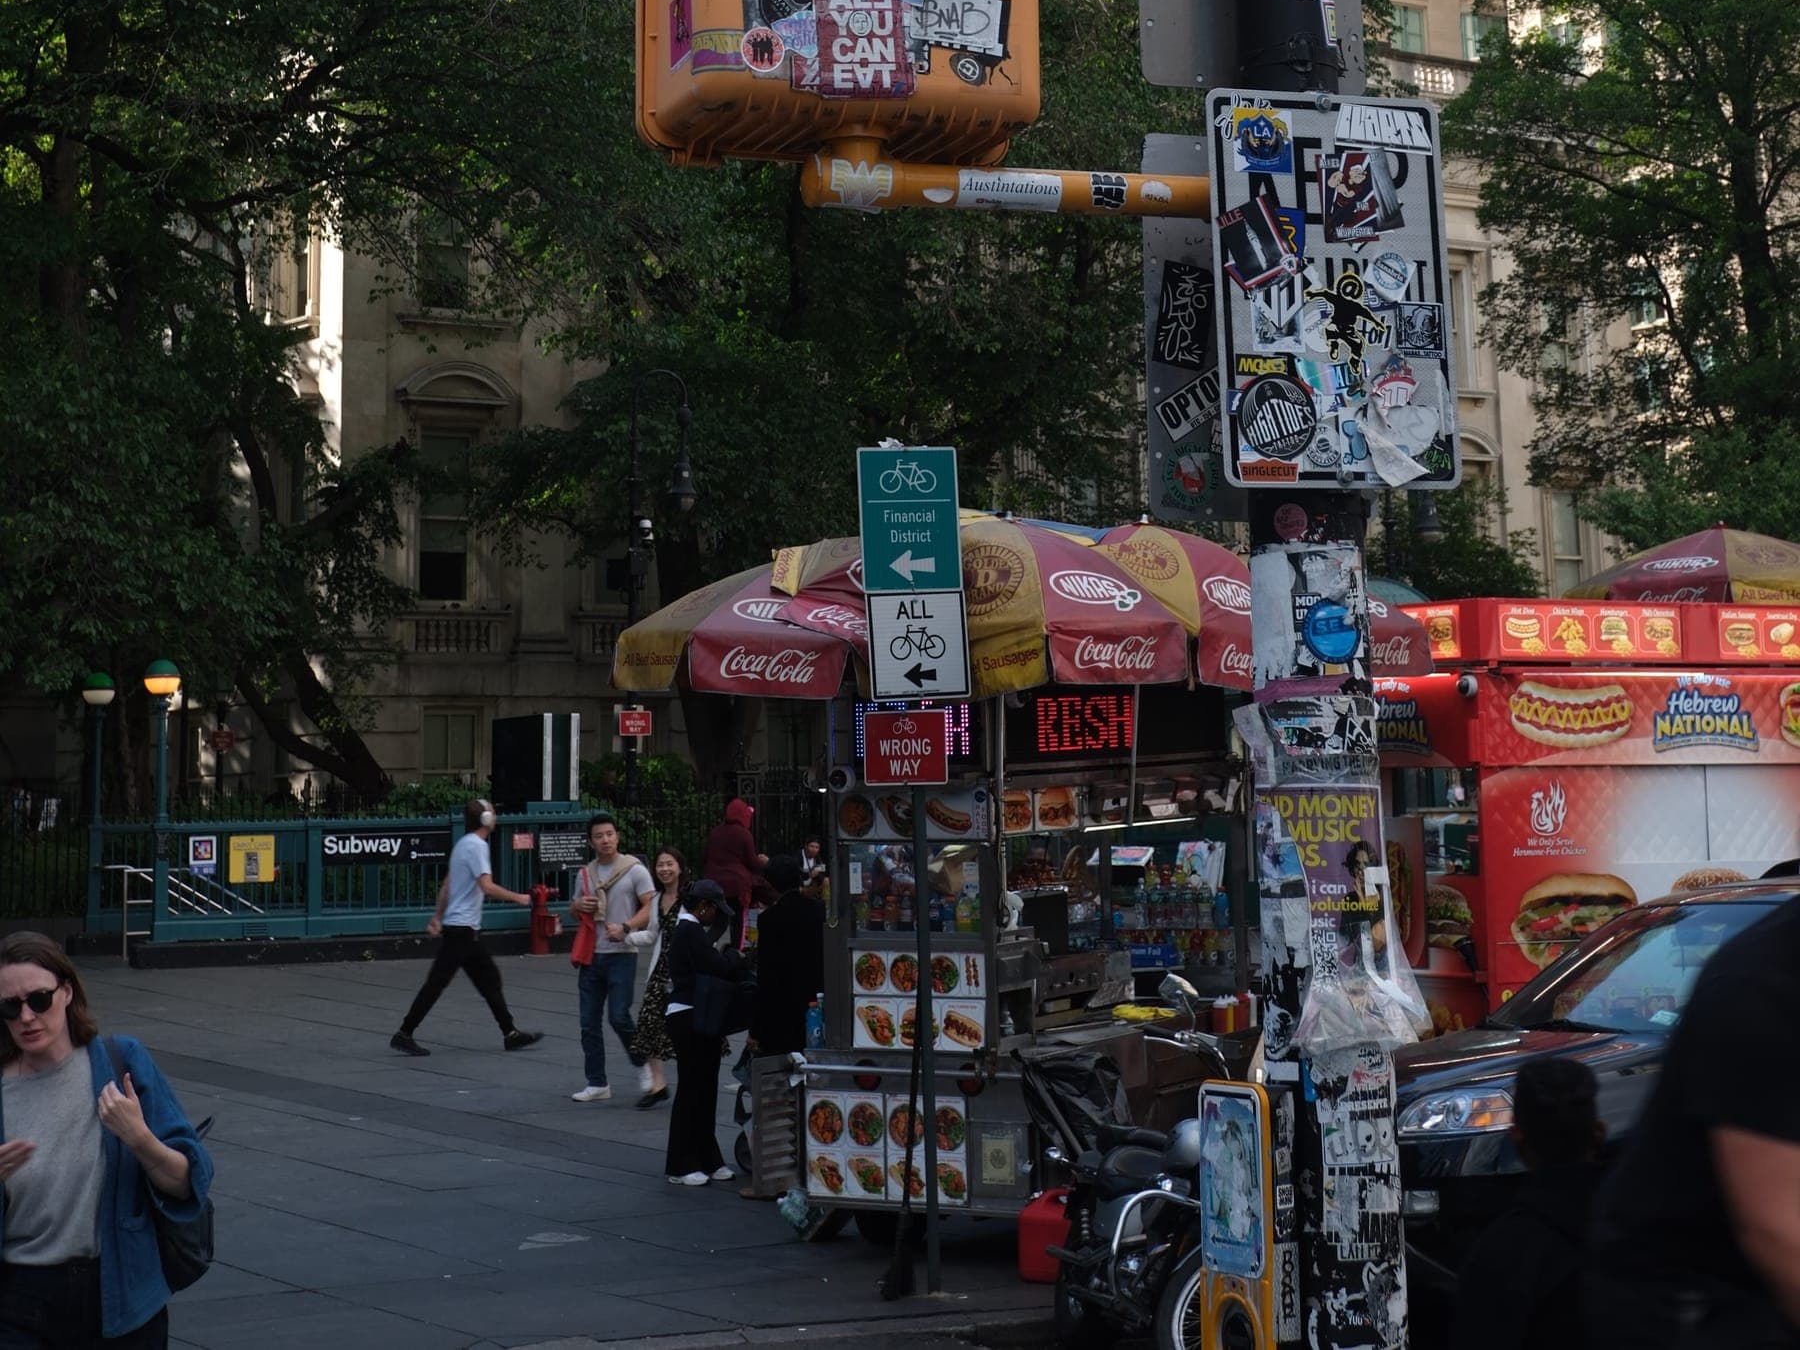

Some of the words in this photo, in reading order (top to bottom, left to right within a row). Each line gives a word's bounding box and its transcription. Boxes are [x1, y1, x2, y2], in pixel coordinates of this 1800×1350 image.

[829, 11, 893, 37] YOU
[832, 38, 895, 63] CAN
[833, 63, 896, 89] EAT
[1254, 125, 1271, 138] LA
[963, 177, 1060, 195] Austintatious
[1247, 400, 1281, 448] HIGH
[1270, 398, 1315, 436] TIDES
[884, 510, 936, 523] Financial
[890, 530, 931, 543] District
[1060, 576, 1119, 599] NIKAS
[1741, 589, 1761, 600] All
[1764, 588, 1785, 600] Beef
[896, 600, 934, 620] ALL
[982, 648, 1039, 671] Sausages
[1075, 635, 1158, 670] Coca-Cola
[720, 646, 821, 684] Coca-Cola
[1668, 690, 1739, 714] Hebrew
[625, 719, 645, 727] WRONG
[1036, 695, 1134, 752] RESH
[1656, 714, 1754, 740] NATIONAL
[880, 738, 931, 756] WRONG
[890, 759, 920, 776] WAY
[1298, 795, 1376, 818] MONEY
[1288, 820, 1360, 843] MUSIC
[323, 836, 402, 857] Subway
[1320, 883, 1347, 895] can
